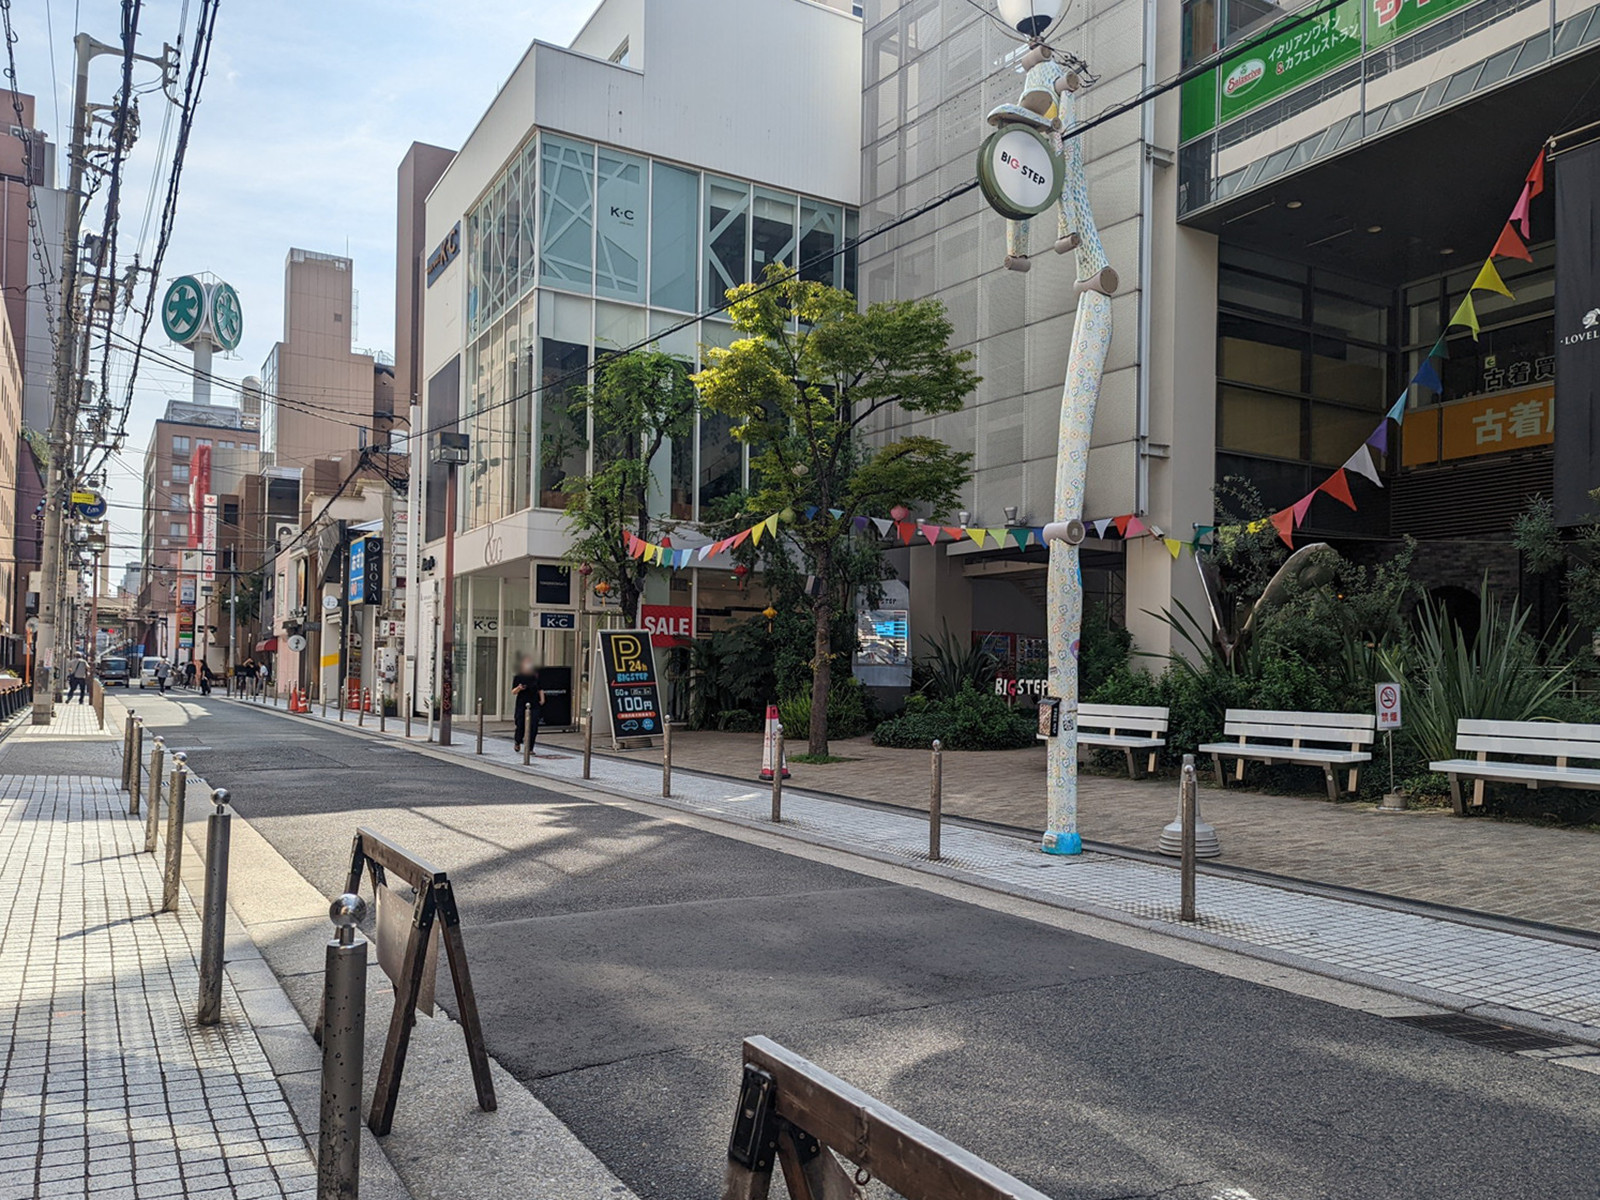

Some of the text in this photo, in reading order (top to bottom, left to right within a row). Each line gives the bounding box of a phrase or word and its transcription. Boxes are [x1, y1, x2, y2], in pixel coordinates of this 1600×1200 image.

[1267, 15, 1341, 62] イタリアンワイン
[1001, 151, 1046, 186] BIG STEP
[1472, 398, 1555, 445] 古着
[369, 562, 379, 601] ROSA
[645, 616, 690, 636] SALE
[611, 635, 642, 672] P
[628, 660, 648, 672] 24h
[617, 696, 653, 712] 100円
